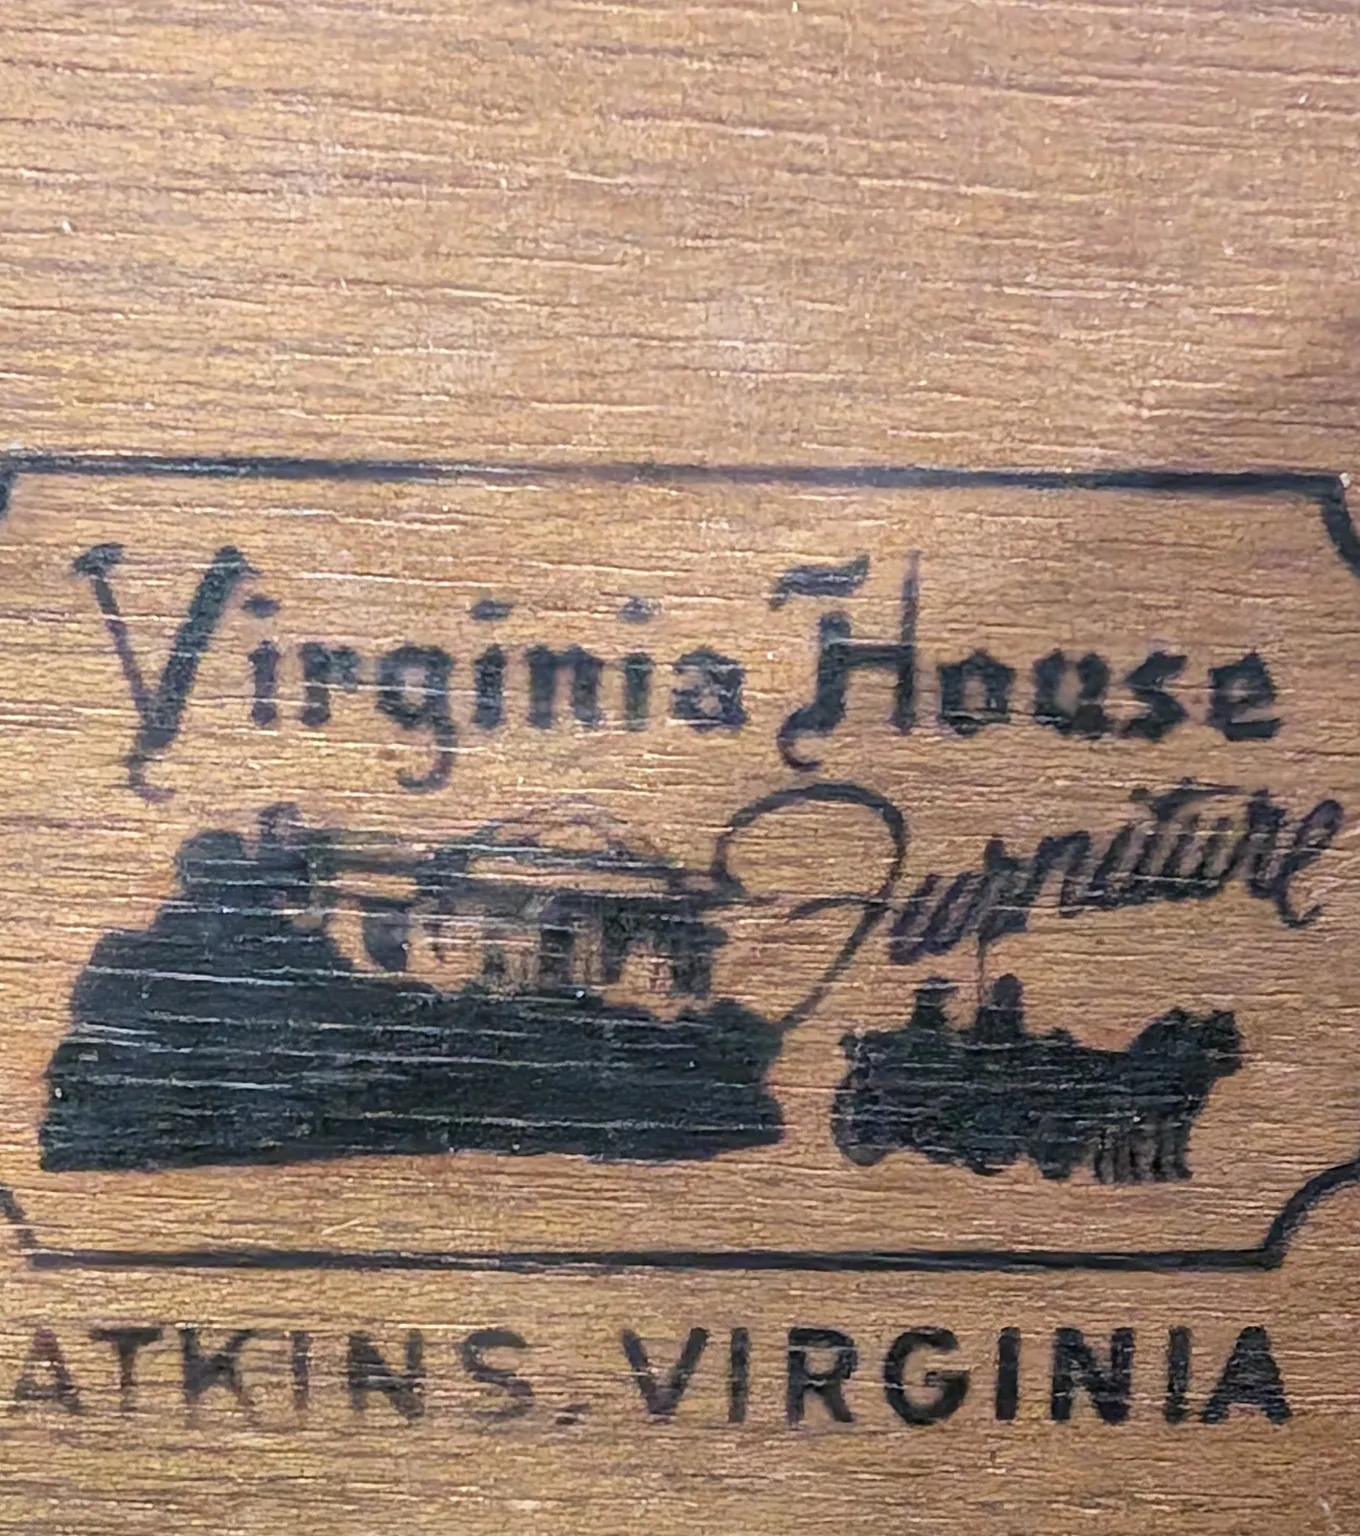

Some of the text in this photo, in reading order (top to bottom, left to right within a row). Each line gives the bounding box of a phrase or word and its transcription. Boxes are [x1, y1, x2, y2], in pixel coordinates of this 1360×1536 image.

[71, 541, 1286, 800] Virginia House
[708, 777, 1343, 1030] Furniture
[621, 1324, 1292, 1426] VIRGINIA
